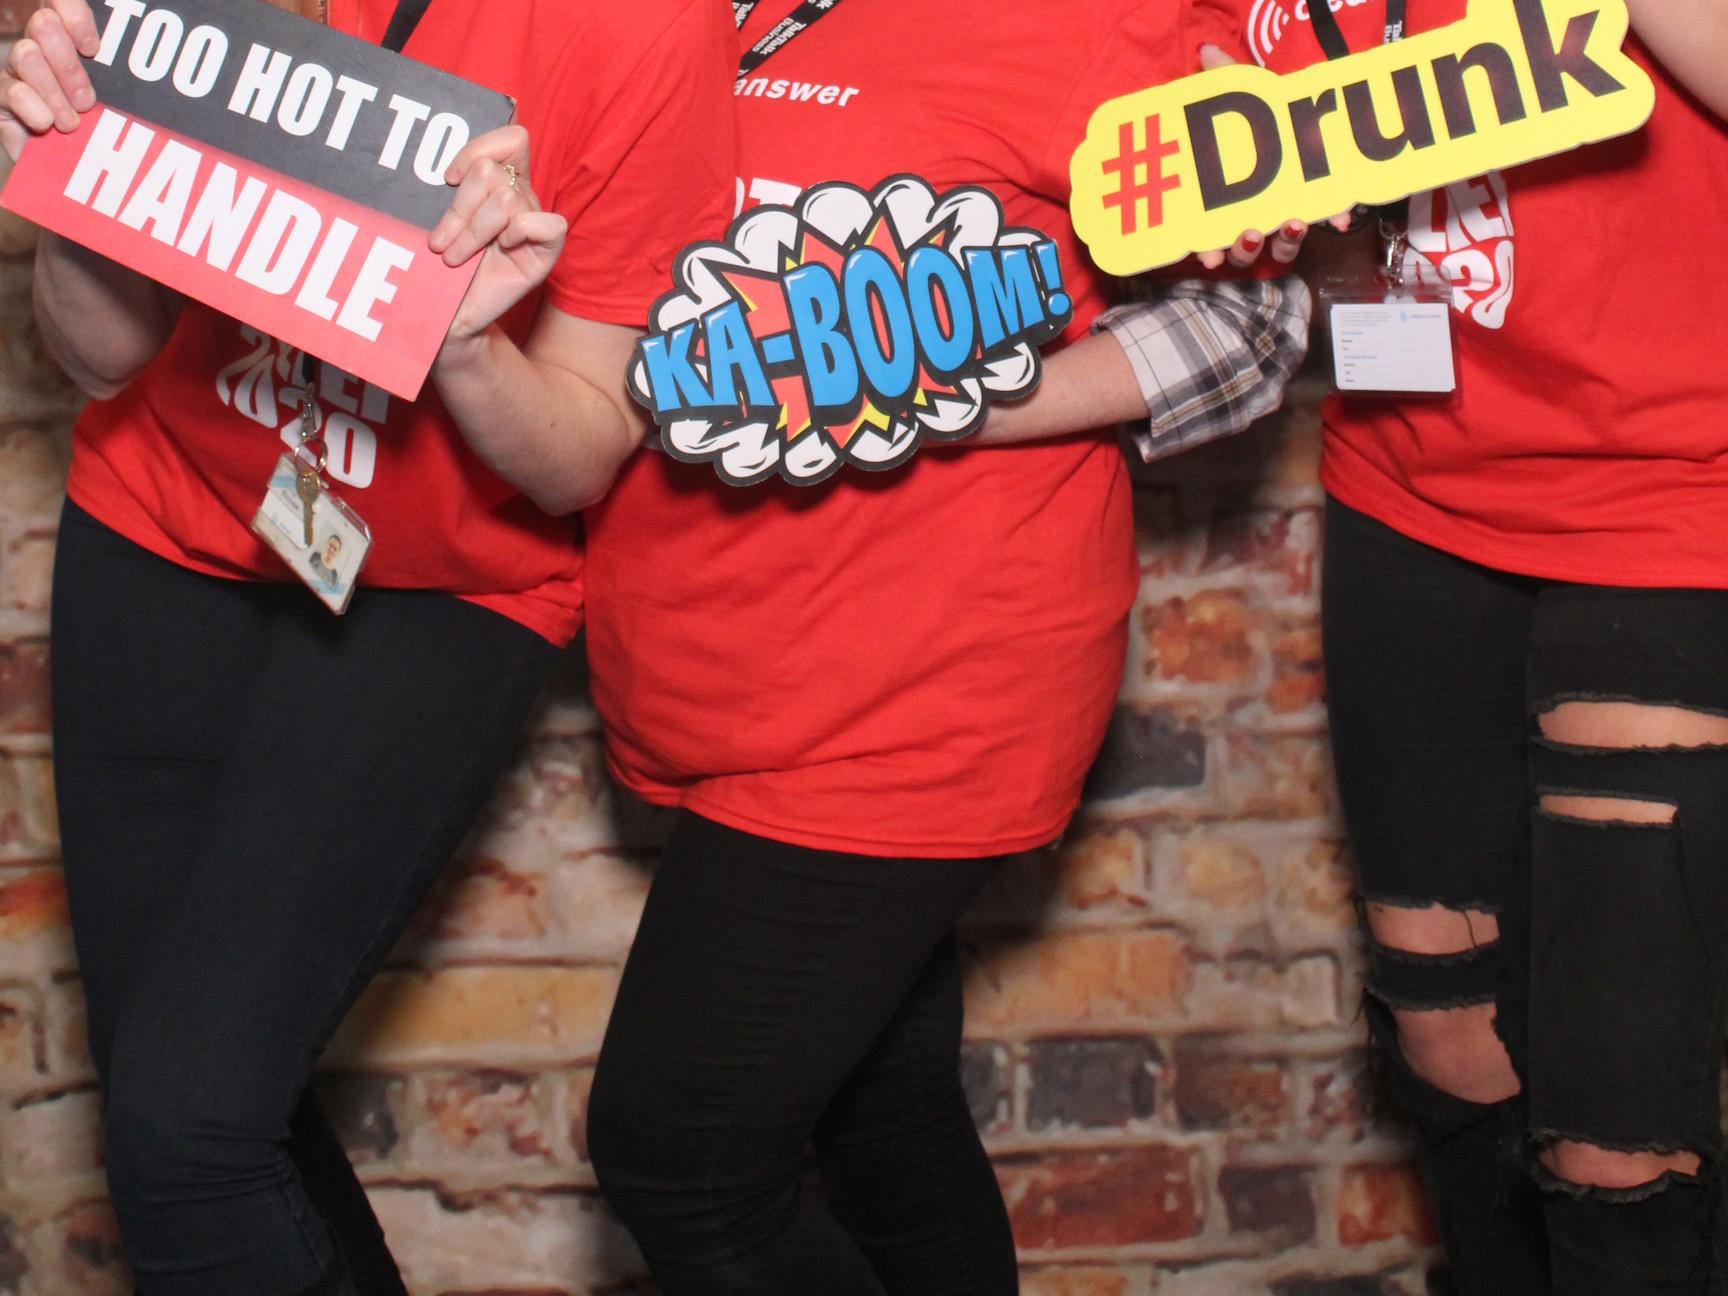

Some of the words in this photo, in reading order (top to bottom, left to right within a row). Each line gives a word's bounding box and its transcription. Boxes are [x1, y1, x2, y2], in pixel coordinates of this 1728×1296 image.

[752, 17, 795, 52] Business
[759, 22, 807, 55] TalkTalk
[229, 43, 378, 150] HOT
[378, 97, 470, 185] TO
[63, 108, 415, 342] HANDLE
[642, 241, 1071, 413] KA-BOOM!
